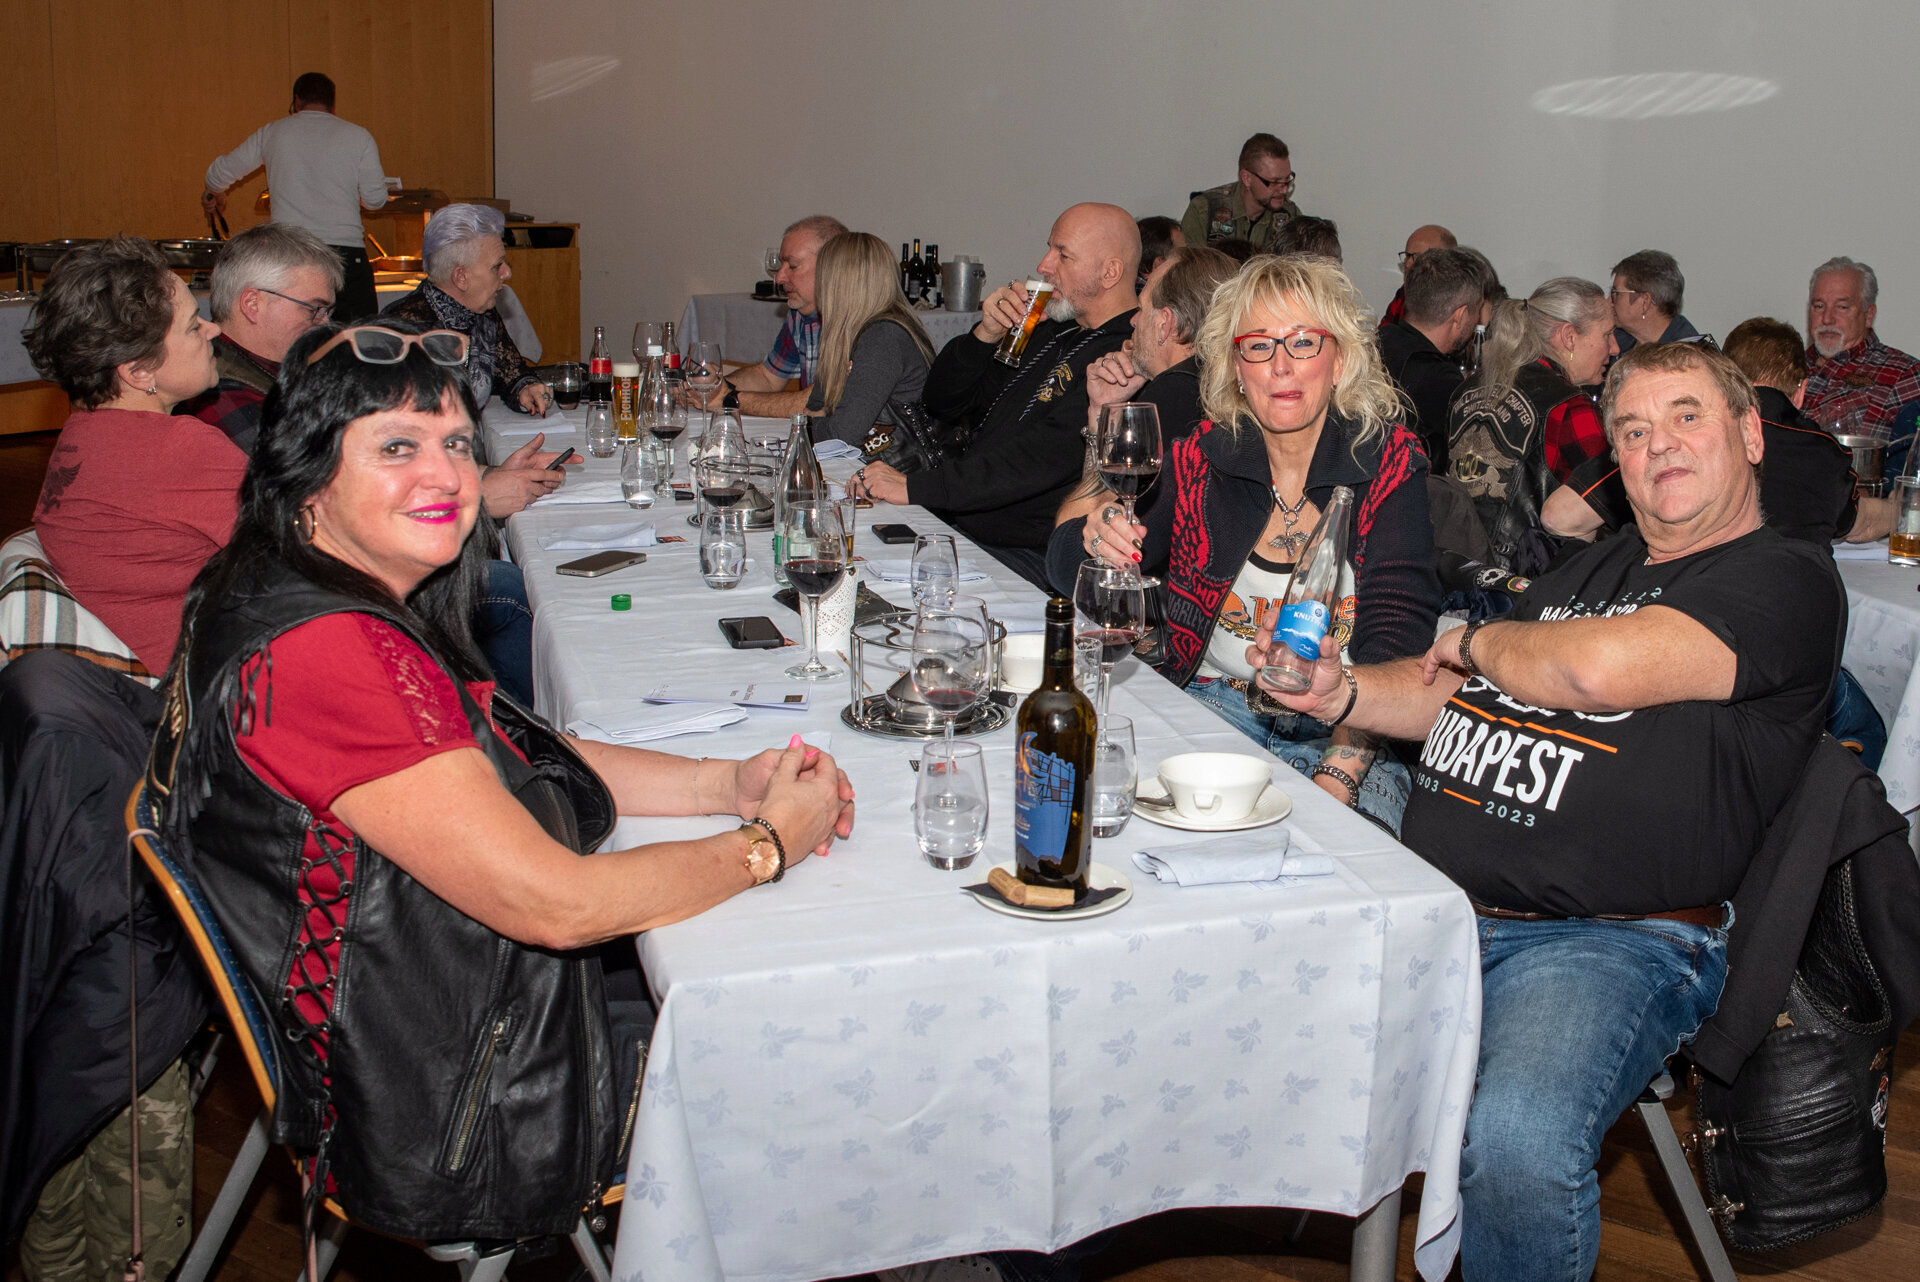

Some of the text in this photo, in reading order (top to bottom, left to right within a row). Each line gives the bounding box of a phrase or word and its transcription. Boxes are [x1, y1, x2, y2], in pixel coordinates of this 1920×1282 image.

[1505, 394, 1532, 428] CHAPTER
[864, 433, 890, 452] HOG
[1420, 707, 1585, 812] BUDAPEST
[1416, 772, 1536, 827] 1903 2023
